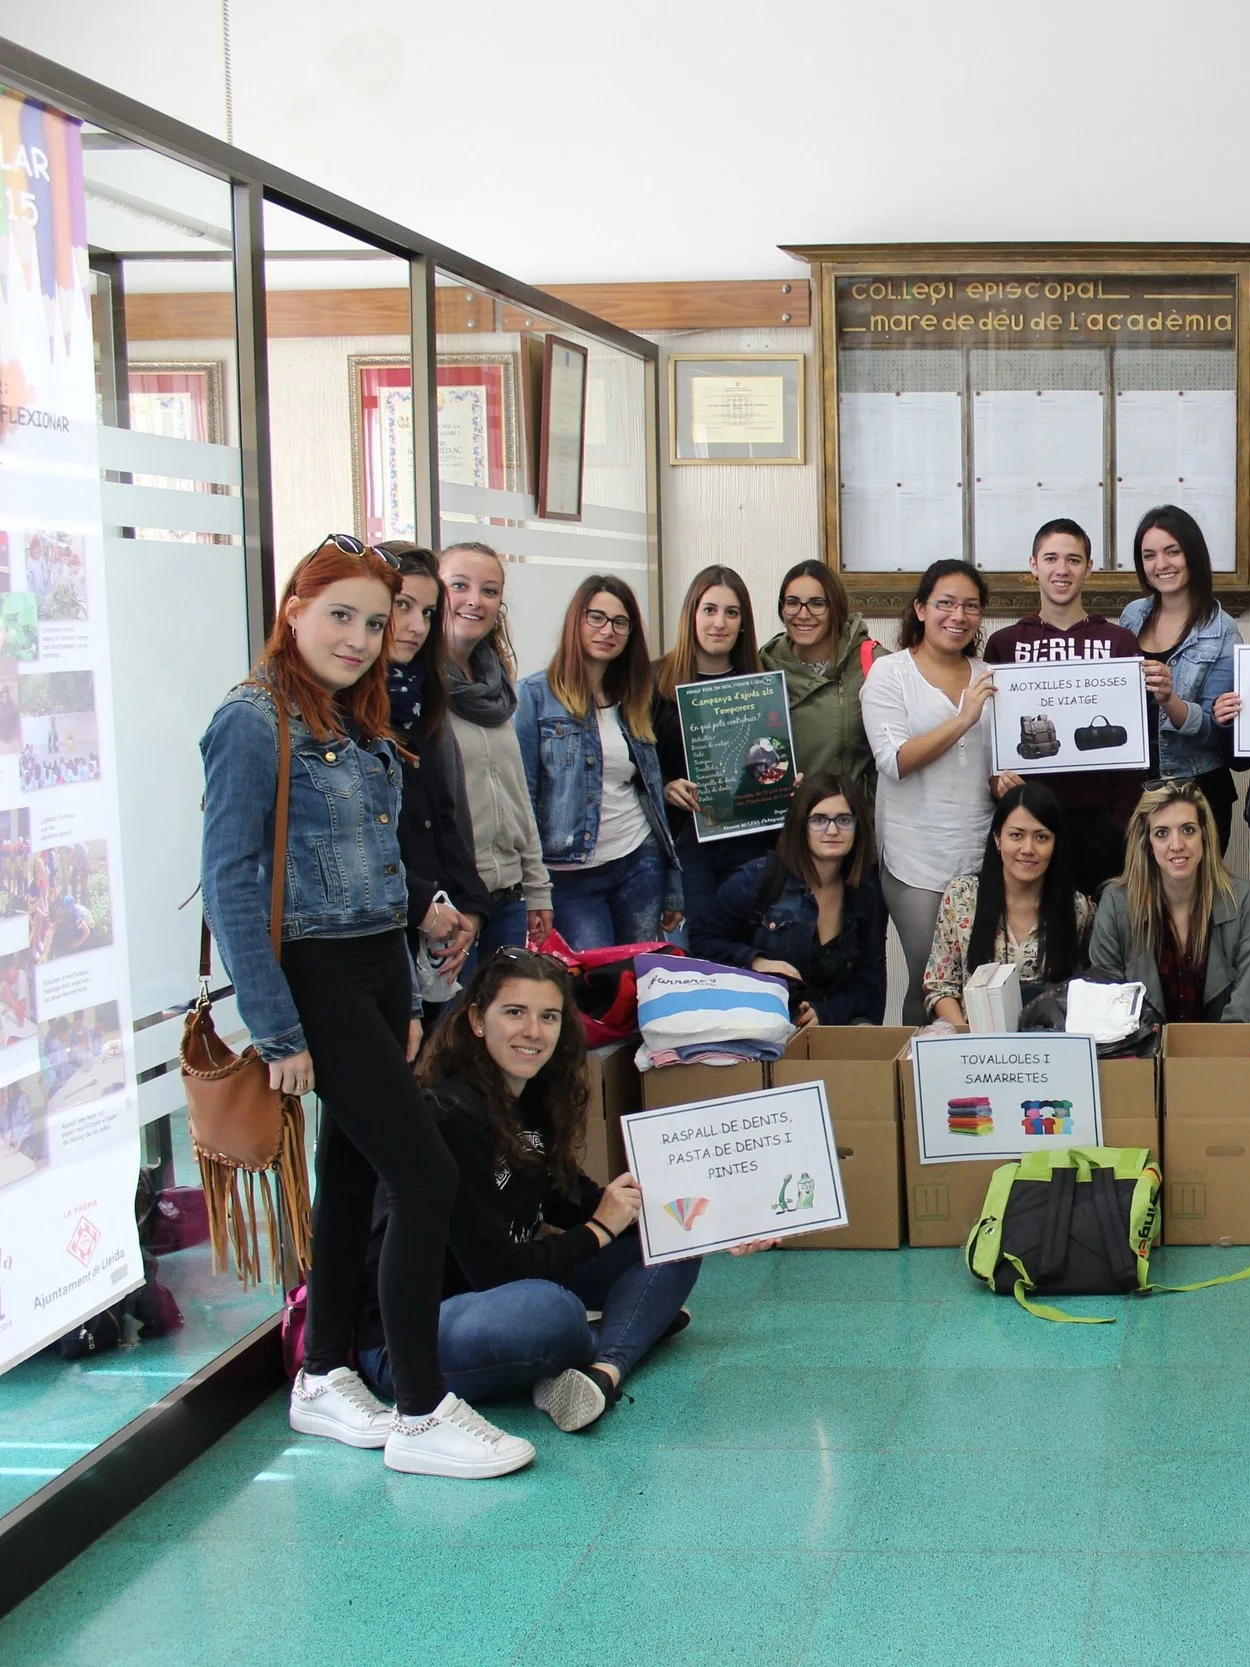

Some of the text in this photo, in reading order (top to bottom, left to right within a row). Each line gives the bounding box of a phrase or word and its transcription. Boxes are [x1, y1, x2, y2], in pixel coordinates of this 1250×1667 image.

[870, 313, 938, 331] mare
[942, 312, 975, 331] de
[978, 309, 1024, 331] déu
[1031, 312, 1063, 331] de
[1015, 637, 1111, 663] BERLIN
[1009, 677, 1127, 692] MOTXILLES I BOSSES
[691, 687, 774, 707] Campanya d'ajuda als
[1040, 695, 1098, 707] DE VIATGE
[713, 703, 756, 716] Temporers
[961, 1053, 1051, 1065] TOVALLOLES I
[965, 1072, 1049, 1084] SAMARRETES
[662, 1112, 793, 1145] RASPALL DE DENTS,
[668, 1132, 792, 1165] PASTA DE DENTS I
[708, 1160, 758, 1180] PINTES
[34, 1248, 126, 1310] Ajuntament de Lleida
